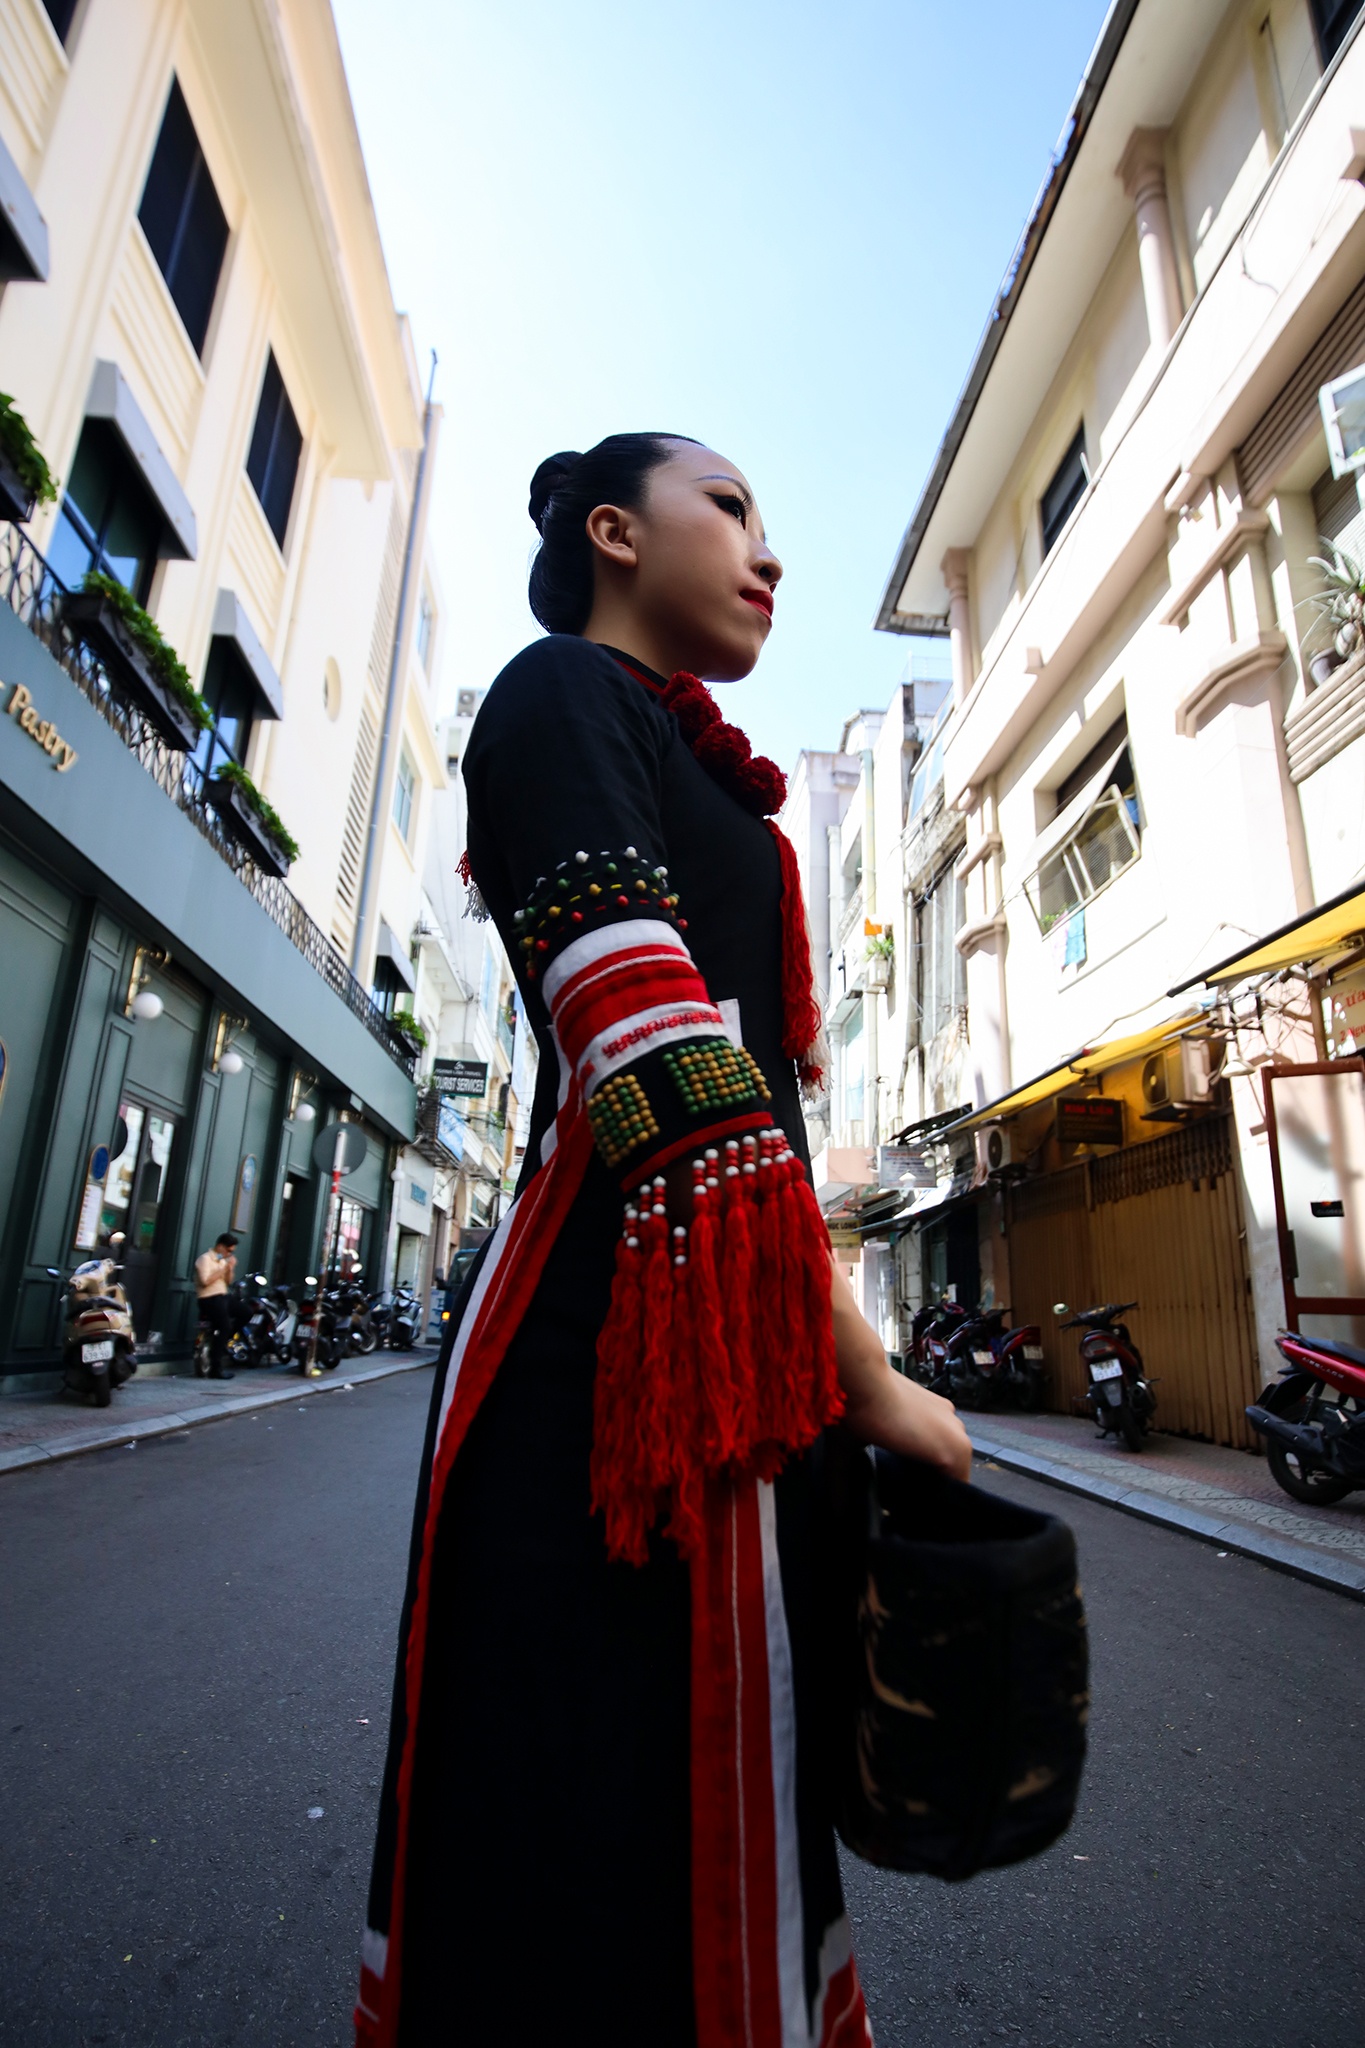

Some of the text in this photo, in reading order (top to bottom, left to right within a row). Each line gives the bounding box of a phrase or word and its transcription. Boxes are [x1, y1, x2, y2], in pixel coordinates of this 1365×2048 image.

[8, 683, 79, 773] Pastry
[456, 1077, 484, 1092] SERVICES
[1064, 1103, 1086, 1113] KIM
